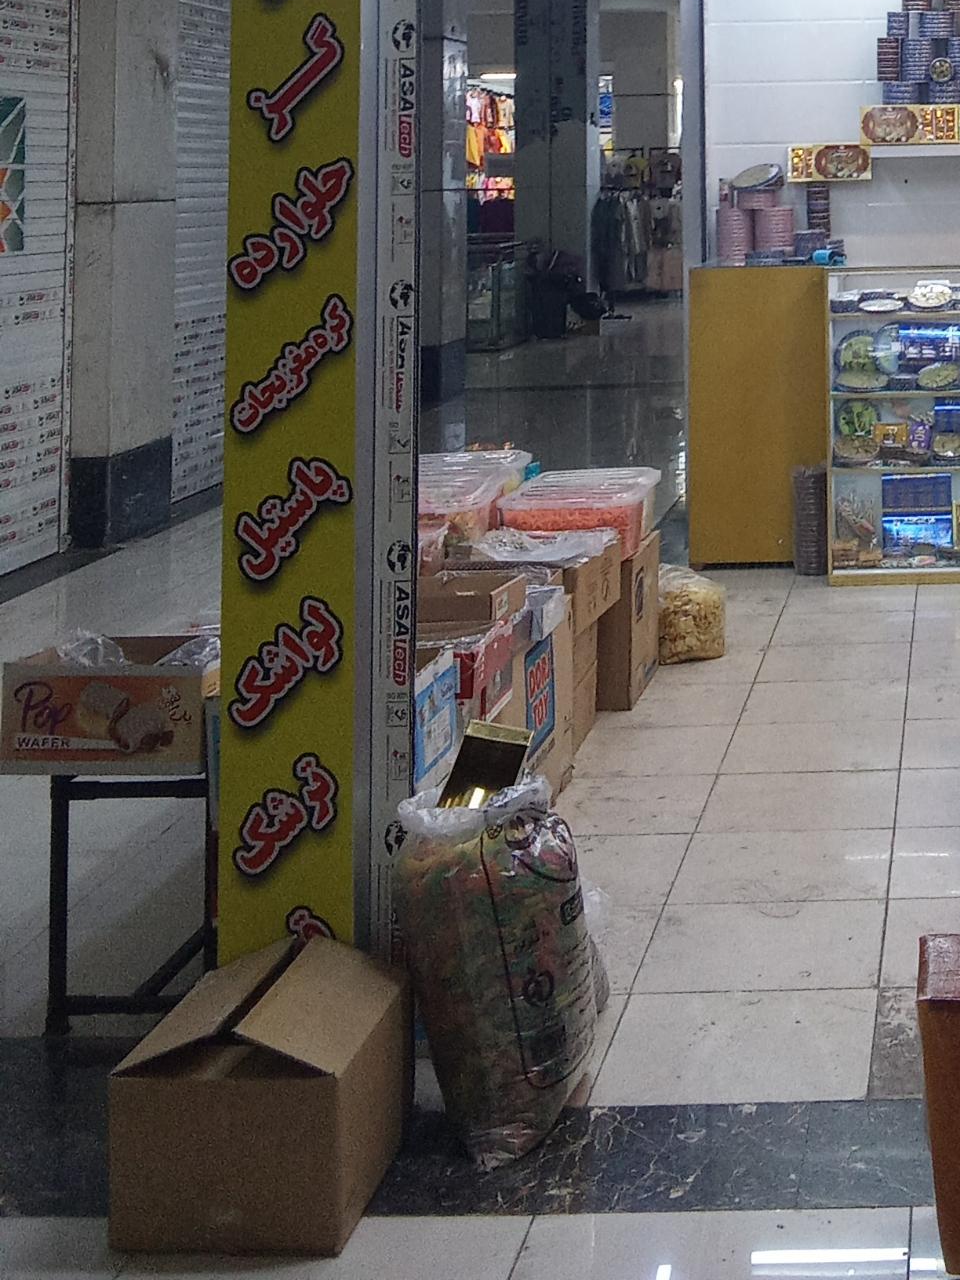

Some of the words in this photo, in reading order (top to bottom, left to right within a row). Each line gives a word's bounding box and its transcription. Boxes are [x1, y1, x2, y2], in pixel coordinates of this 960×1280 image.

[399, 63, 415, 159] ASATech
[235, 456, 353, 583] پاستیل
[228, 595, 344, 729] لواشک
[392, 586, 410, 687] ASATech
[16, 736, 71, 749] WAFER
[232, 752, 339, 879] ترشک
